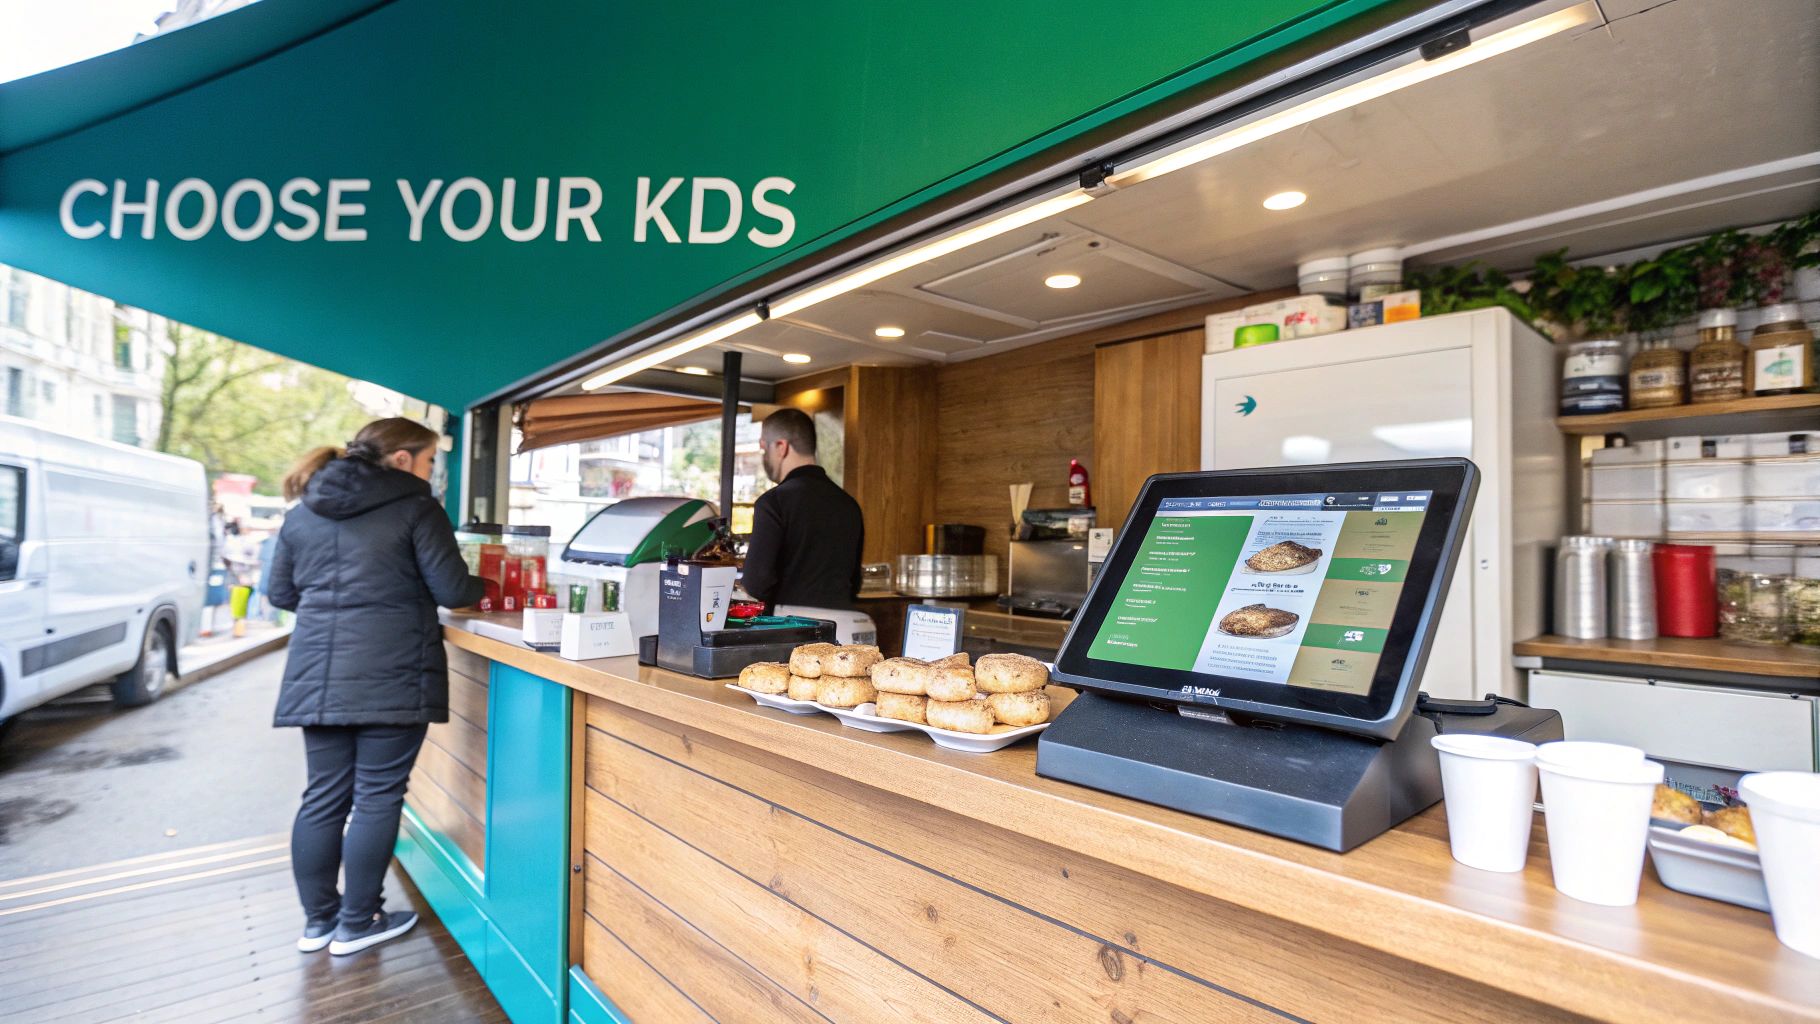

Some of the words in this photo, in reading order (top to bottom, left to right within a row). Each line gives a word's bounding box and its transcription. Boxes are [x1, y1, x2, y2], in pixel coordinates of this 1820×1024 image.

[59, 177, 371, 242] CHOOSE
[397, 177, 603, 243] YOUR
[633, 176, 797, 248] KDS
